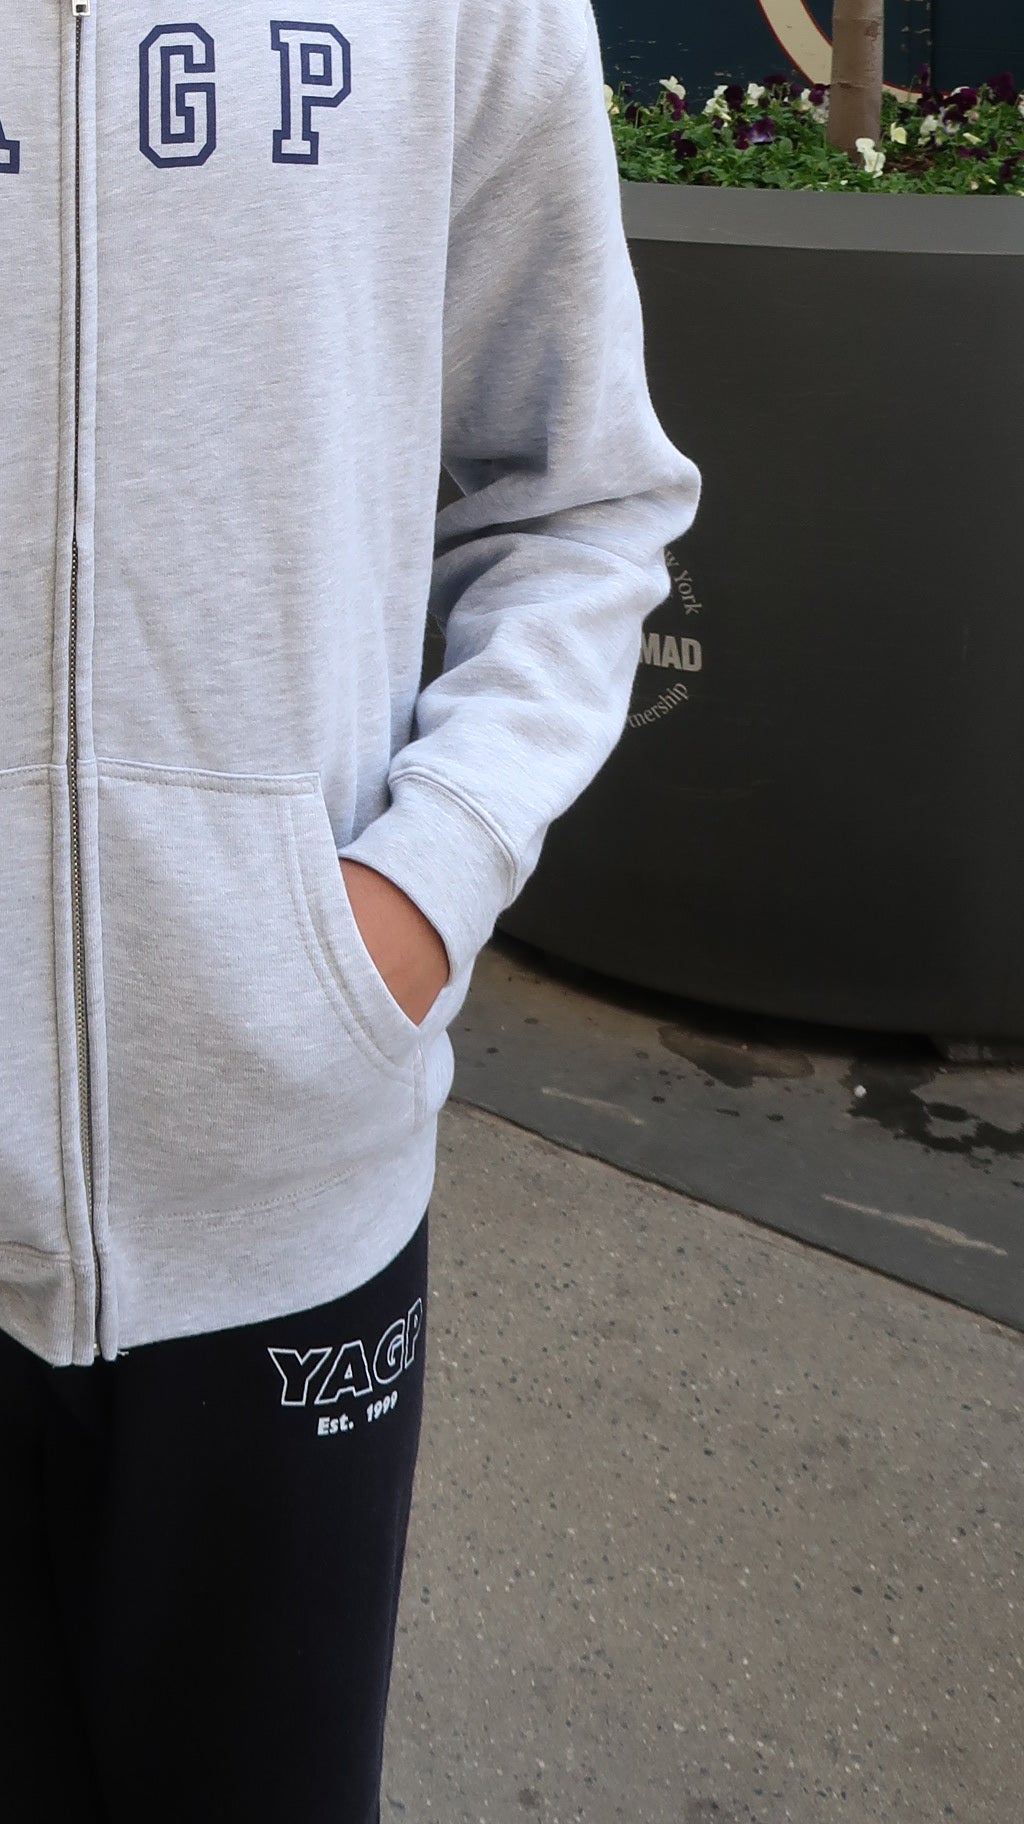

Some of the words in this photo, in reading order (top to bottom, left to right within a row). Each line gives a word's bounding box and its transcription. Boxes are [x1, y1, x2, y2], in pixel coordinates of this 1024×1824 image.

[674, 569, 704, 616] York
[638, 632, 704, 673] MAD
[627, 682, 689, 729] tnership
[267, 1297, 423, 1407] YAGP
[317, 1414, 355, 1437] Est.
[366, 1390, 399, 1424] 1999
